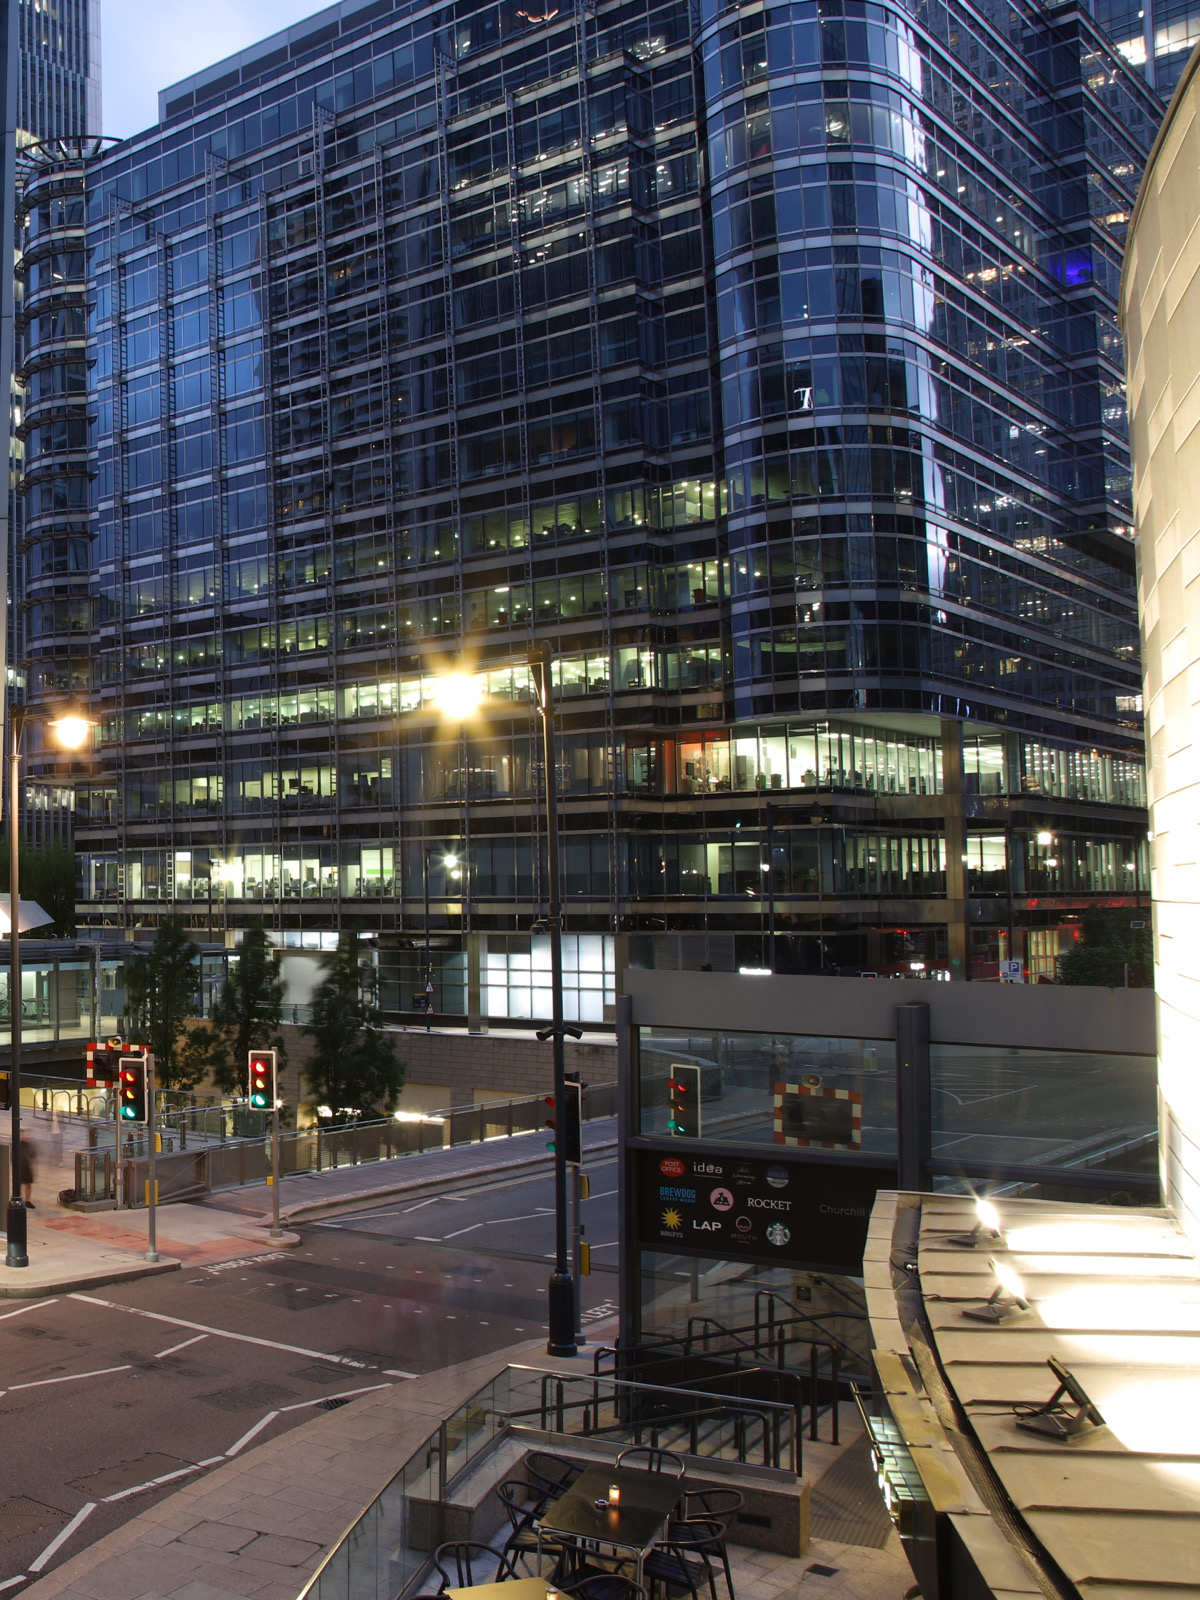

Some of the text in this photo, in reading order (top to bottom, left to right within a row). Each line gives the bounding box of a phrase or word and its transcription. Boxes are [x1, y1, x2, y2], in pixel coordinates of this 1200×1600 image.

[1010, 963, 1018, 972] P
[693, 1161, 723, 1174] idea
[659, 1186, 696, 1199] BREWDOG
[747, 1197, 792, 1211] ROCKET
[819, 1204, 865, 1216] Churchill
[693, 1220, 722, 1231] LAP
[731, 1232, 757, 1241] MOUTH
[580, 1303, 620, 1319] LEFT
